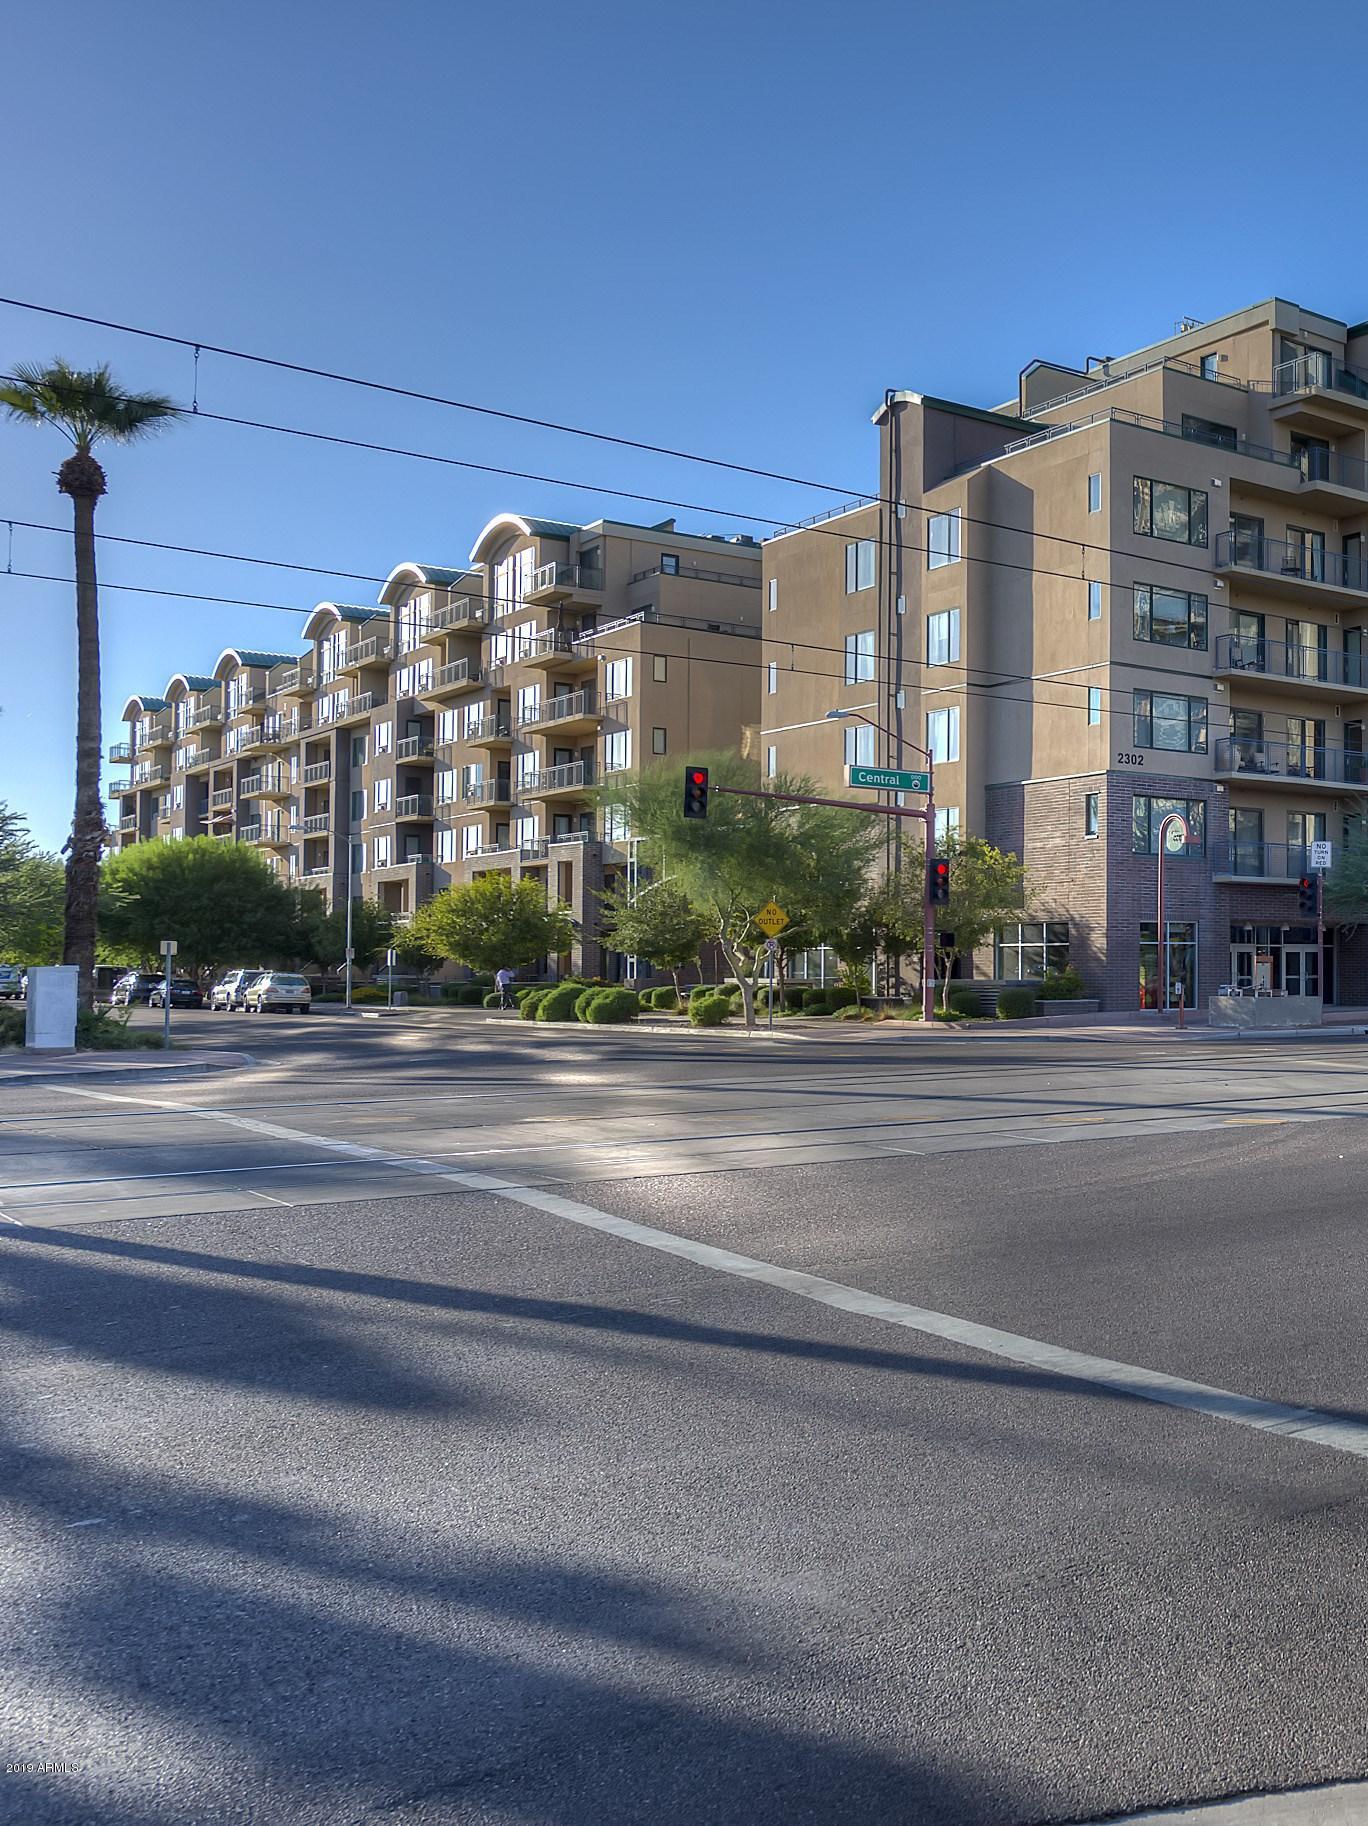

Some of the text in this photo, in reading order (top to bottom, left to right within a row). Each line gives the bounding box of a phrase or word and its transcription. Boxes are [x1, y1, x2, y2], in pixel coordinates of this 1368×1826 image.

[1117, 752, 1144, 766] 2302
[858, 772, 900, 785] Central
[766, 908, 777, 916] NO
[758, 918, 785, 926] OUTLET
